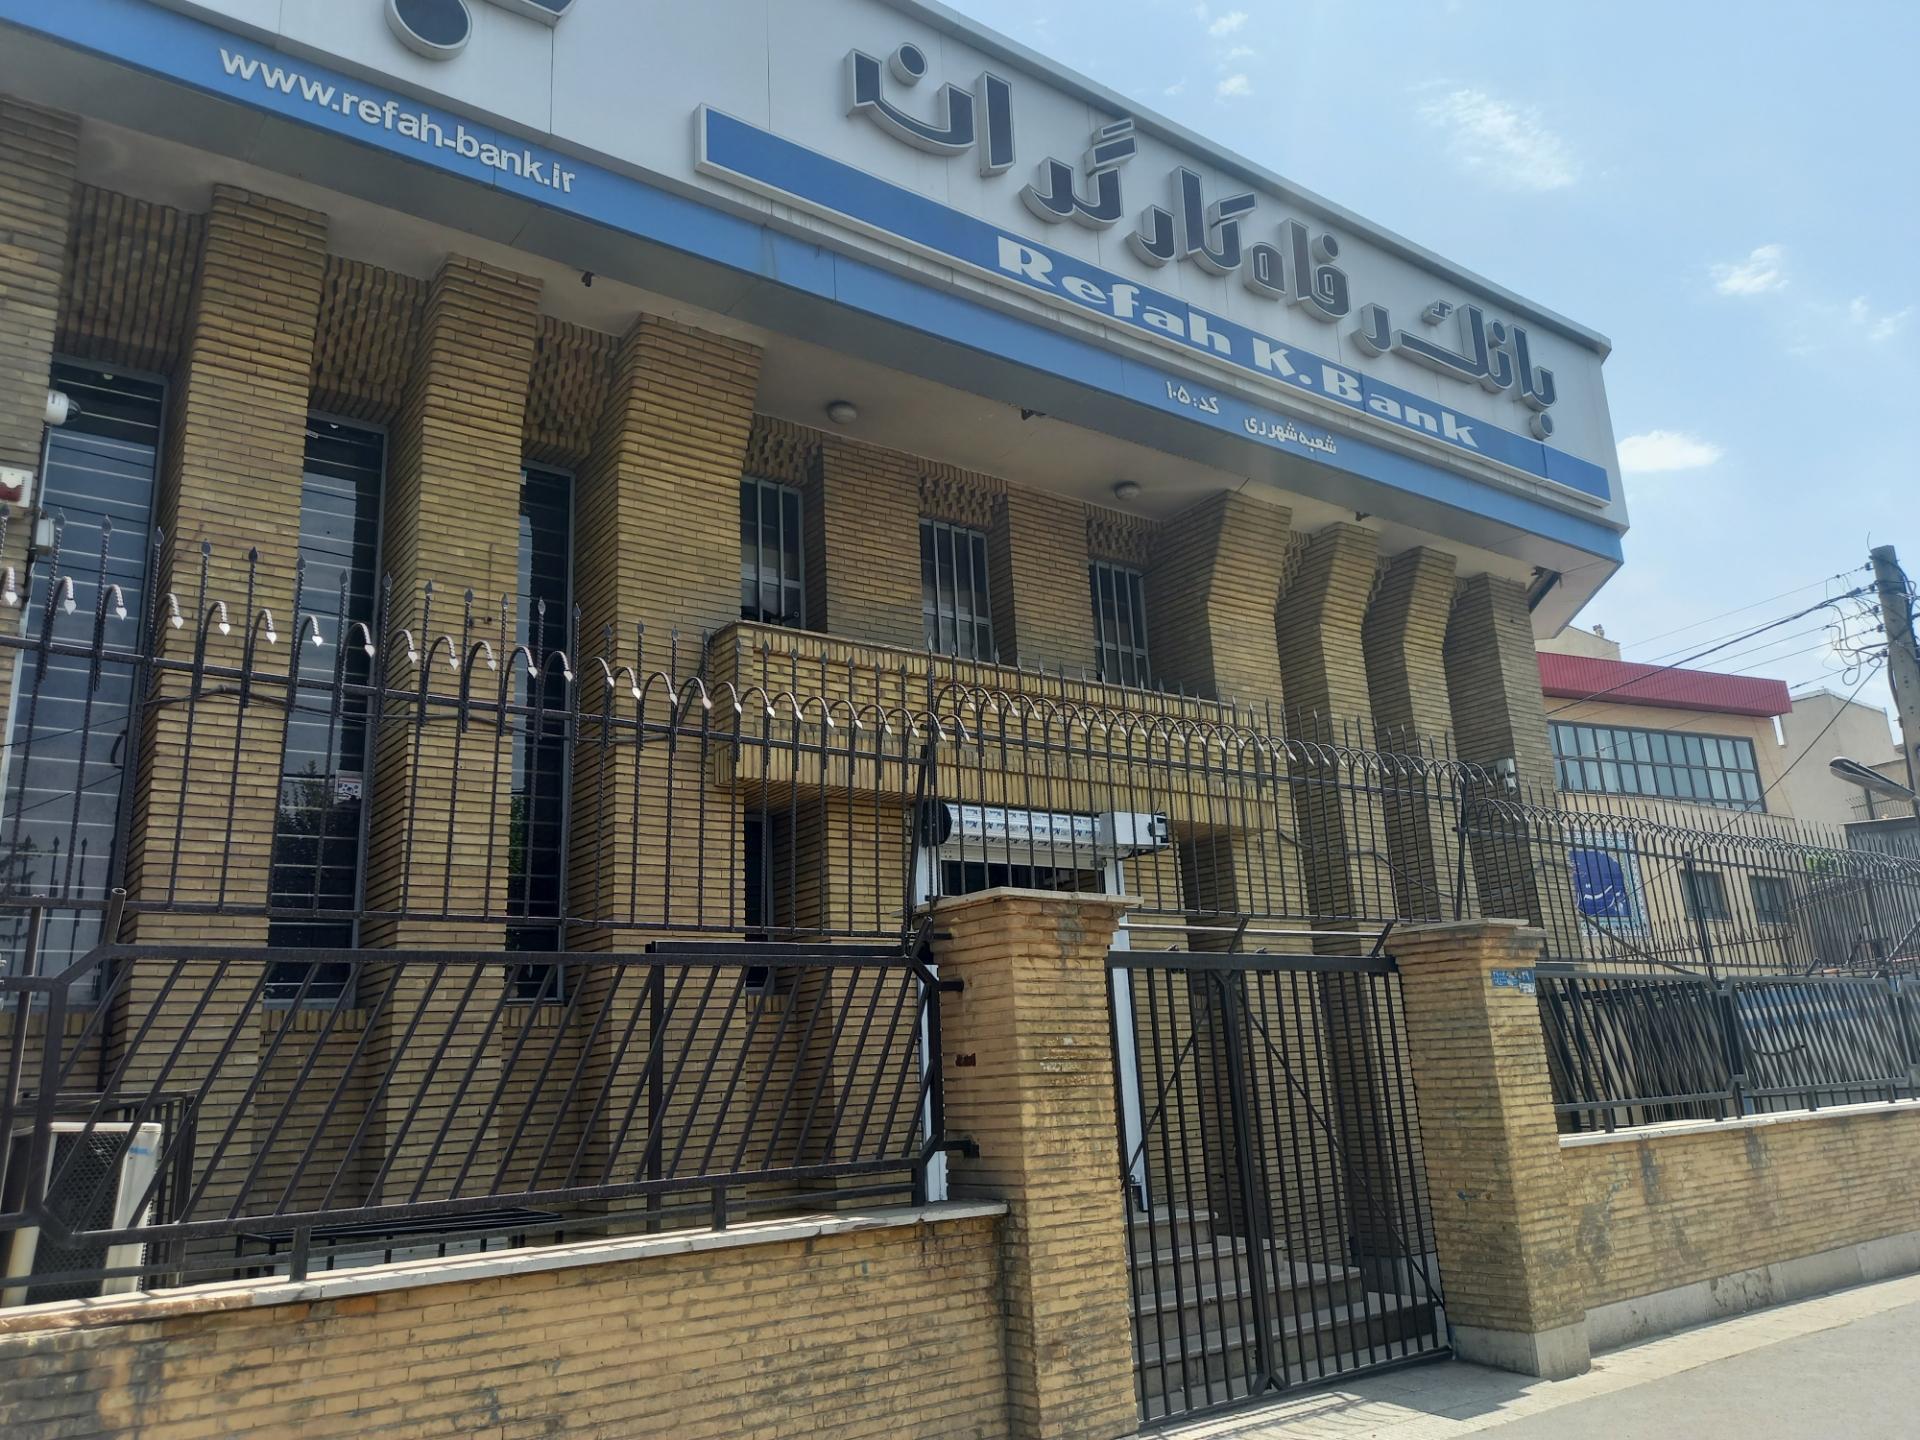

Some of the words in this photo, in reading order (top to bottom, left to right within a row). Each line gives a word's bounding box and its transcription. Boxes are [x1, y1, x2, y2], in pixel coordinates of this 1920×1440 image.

[219, 47, 575, 193] www.refah-bank.ir
[843, 42, 1257, 276] کارگران
[997, 236, 1232, 356] Refah
[1242, 217, 1394, 357] رفاه
[1392, 299, 1558, 441] بانک
[1298, 432, 1338, 455] شعبه
